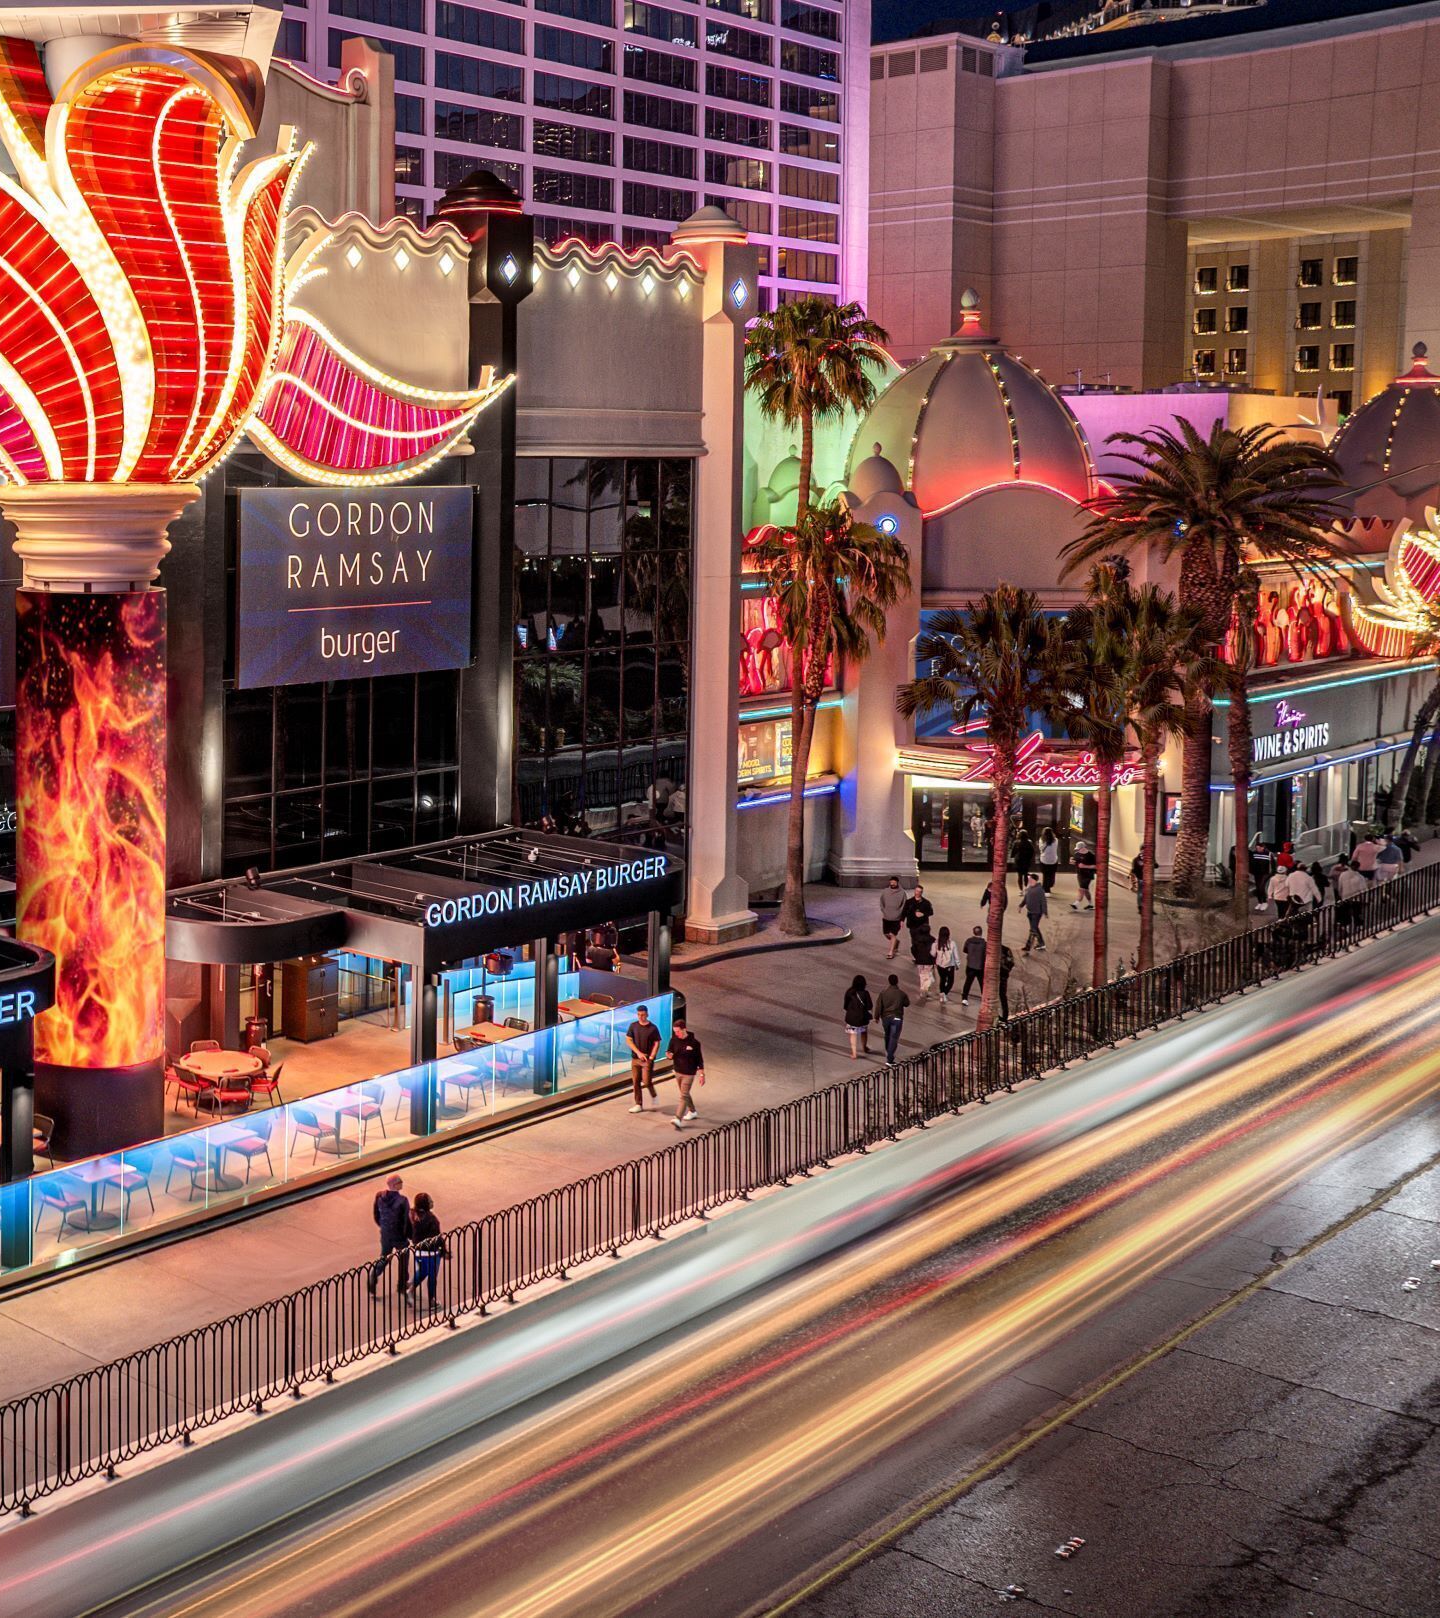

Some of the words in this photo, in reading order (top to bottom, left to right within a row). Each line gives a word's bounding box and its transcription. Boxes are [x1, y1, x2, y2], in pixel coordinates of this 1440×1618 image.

[289, 501, 433, 538] GORDON
[287, 550, 432, 589] RAMSAY
[321, 627, 400, 663] burger
[1253, 733, 1282, 762] WINE
[1283, 731, 1293, 755] &
[1293, 722, 1329, 753] SPIRITS
[427, 887, 513, 928] GORDON
[518, 870, 592, 908] RAMSAY
[596, 856, 666, 891] BURGER
